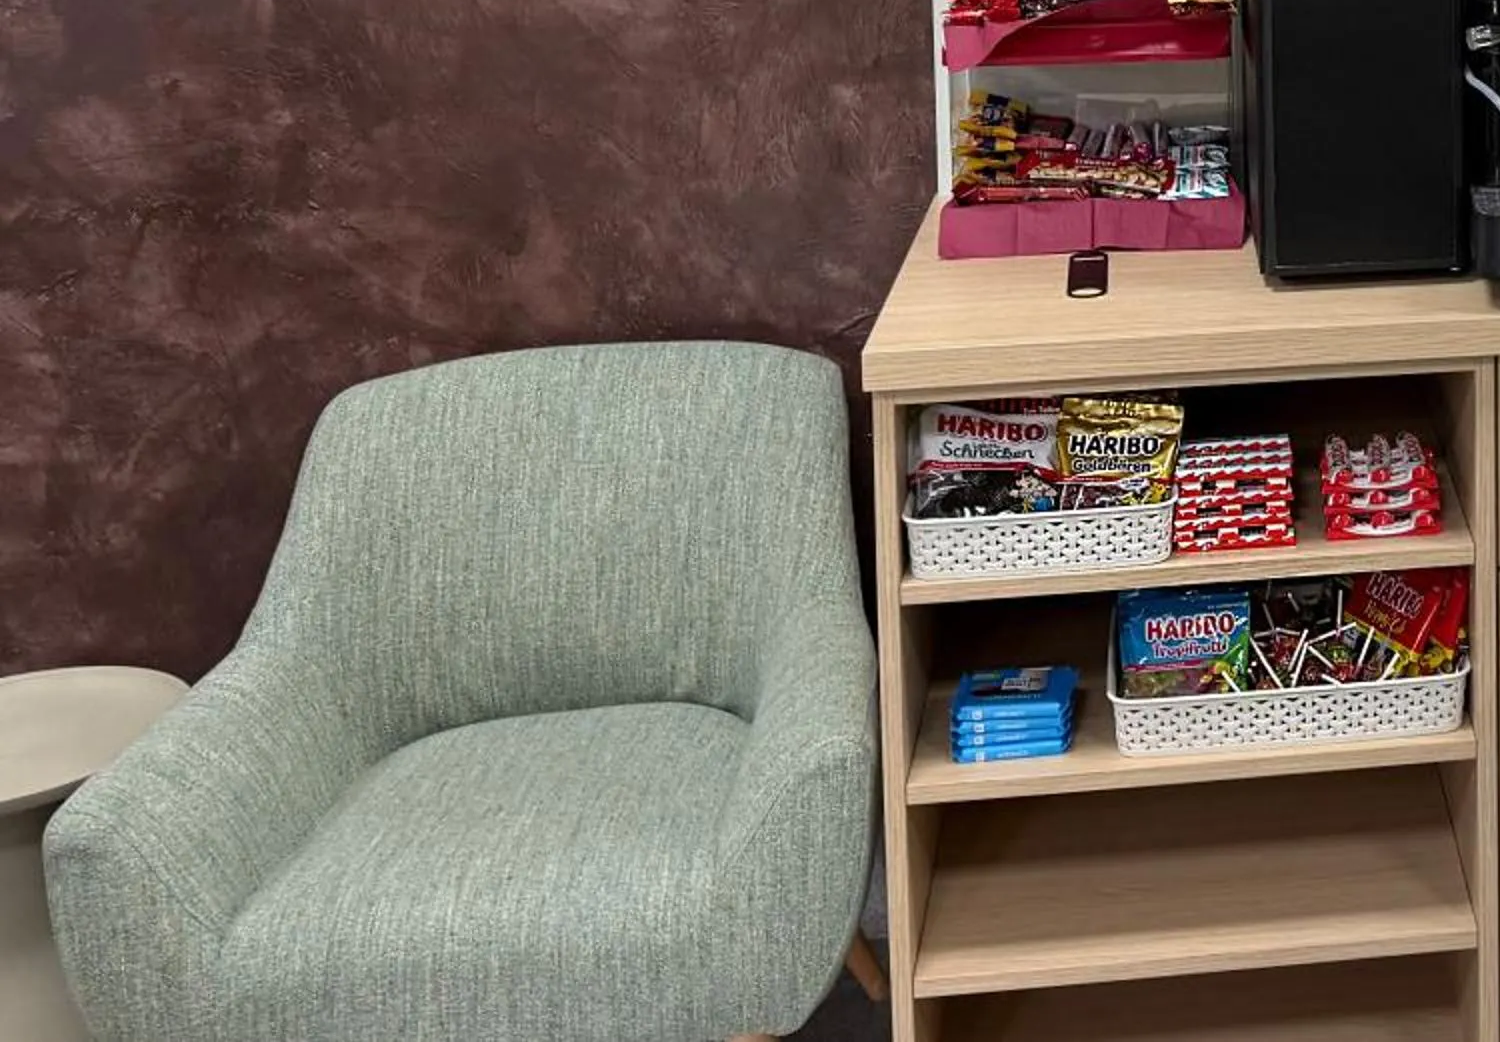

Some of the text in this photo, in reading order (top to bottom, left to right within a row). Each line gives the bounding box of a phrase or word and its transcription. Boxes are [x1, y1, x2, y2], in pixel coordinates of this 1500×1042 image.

[937, 413, 1048, 442] HARIBO
[940, 439, 1035, 459] Schnecken
[1069, 432, 1161, 458] HARIBO
[1145, 611, 1236, 642] HARIBO
